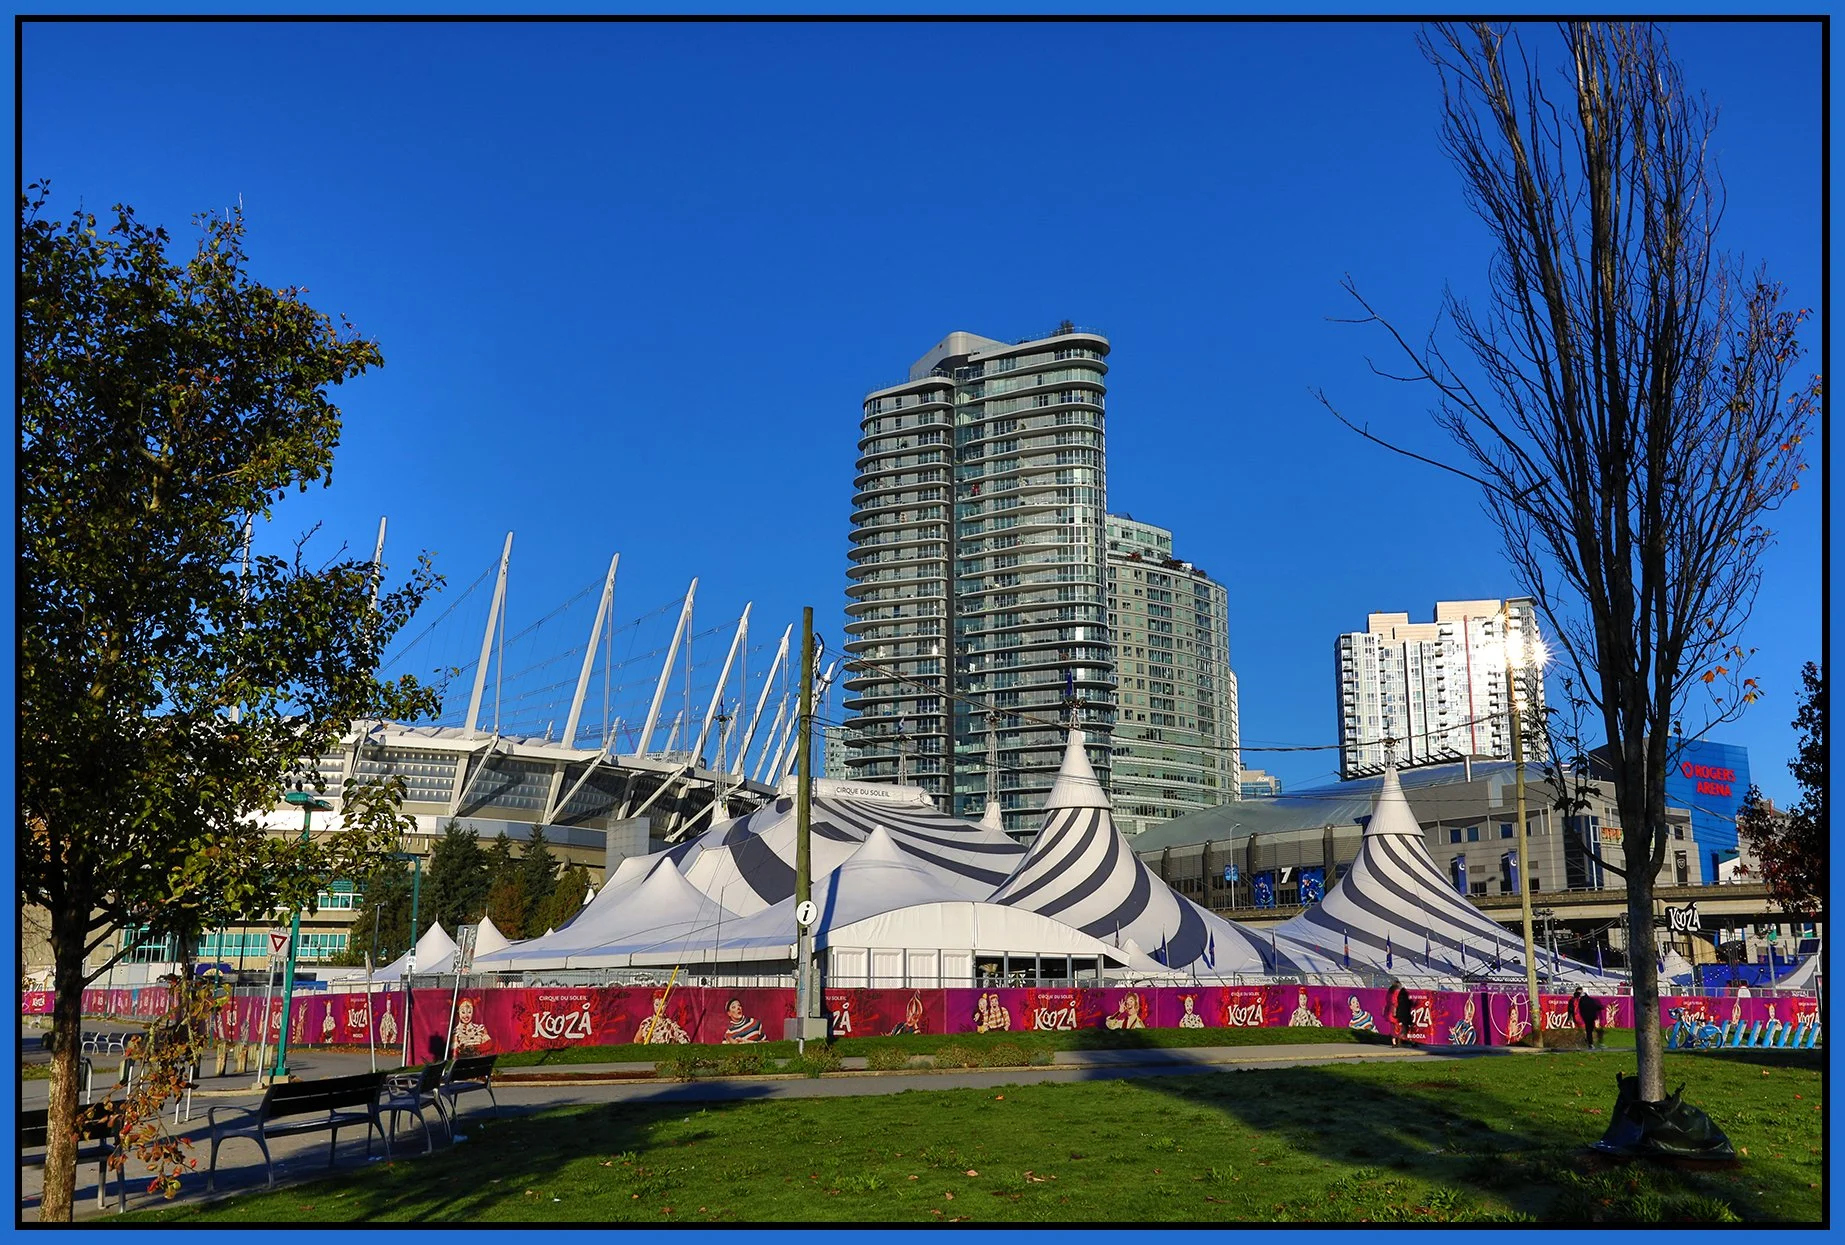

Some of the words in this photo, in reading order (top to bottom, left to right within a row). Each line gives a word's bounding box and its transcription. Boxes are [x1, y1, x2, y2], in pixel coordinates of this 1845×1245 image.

[1695, 763, 1736, 782] ROGERS
[836, 787, 858, 795] CIRQUE
[1696, 781, 1732, 797] ARENA
[1281, 866, 1293, 884] 7
